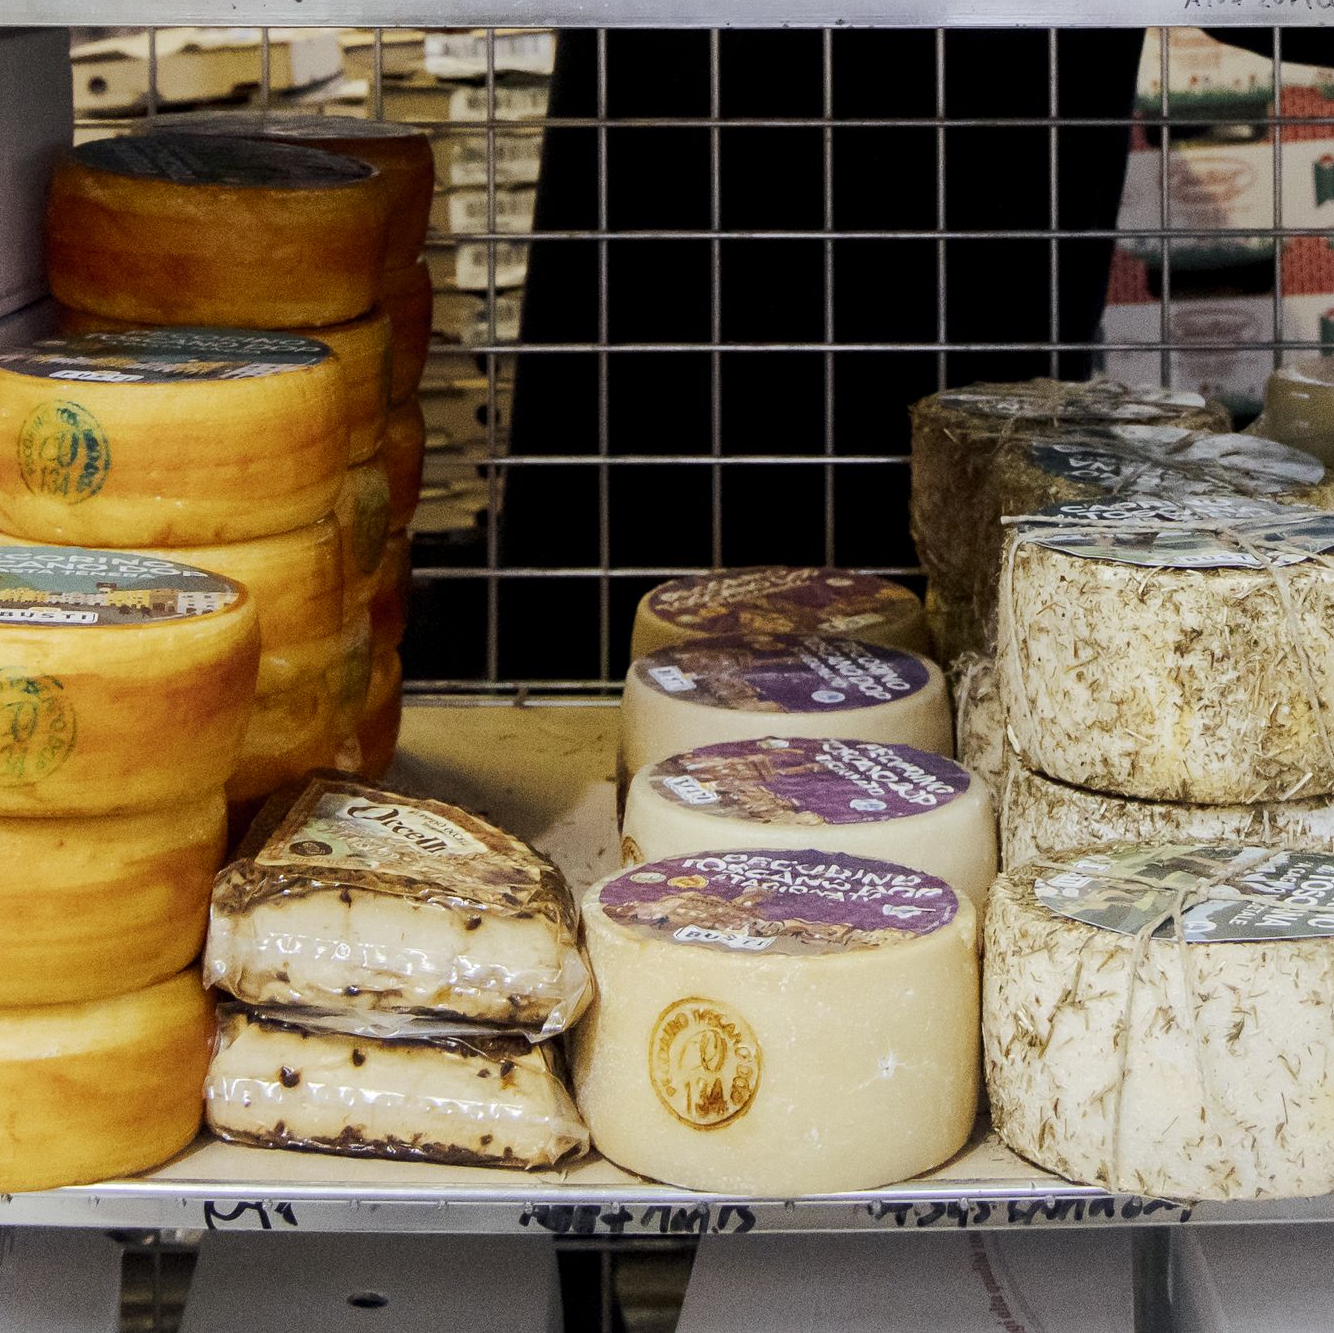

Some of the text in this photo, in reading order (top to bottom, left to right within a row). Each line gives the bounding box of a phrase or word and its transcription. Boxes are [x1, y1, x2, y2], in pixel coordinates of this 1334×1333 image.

[1184, 553, 1249, 565] BUST
[0, 611, 88, 621] BUSTI
[1254, 873, 1334, 928] TOSCNA
